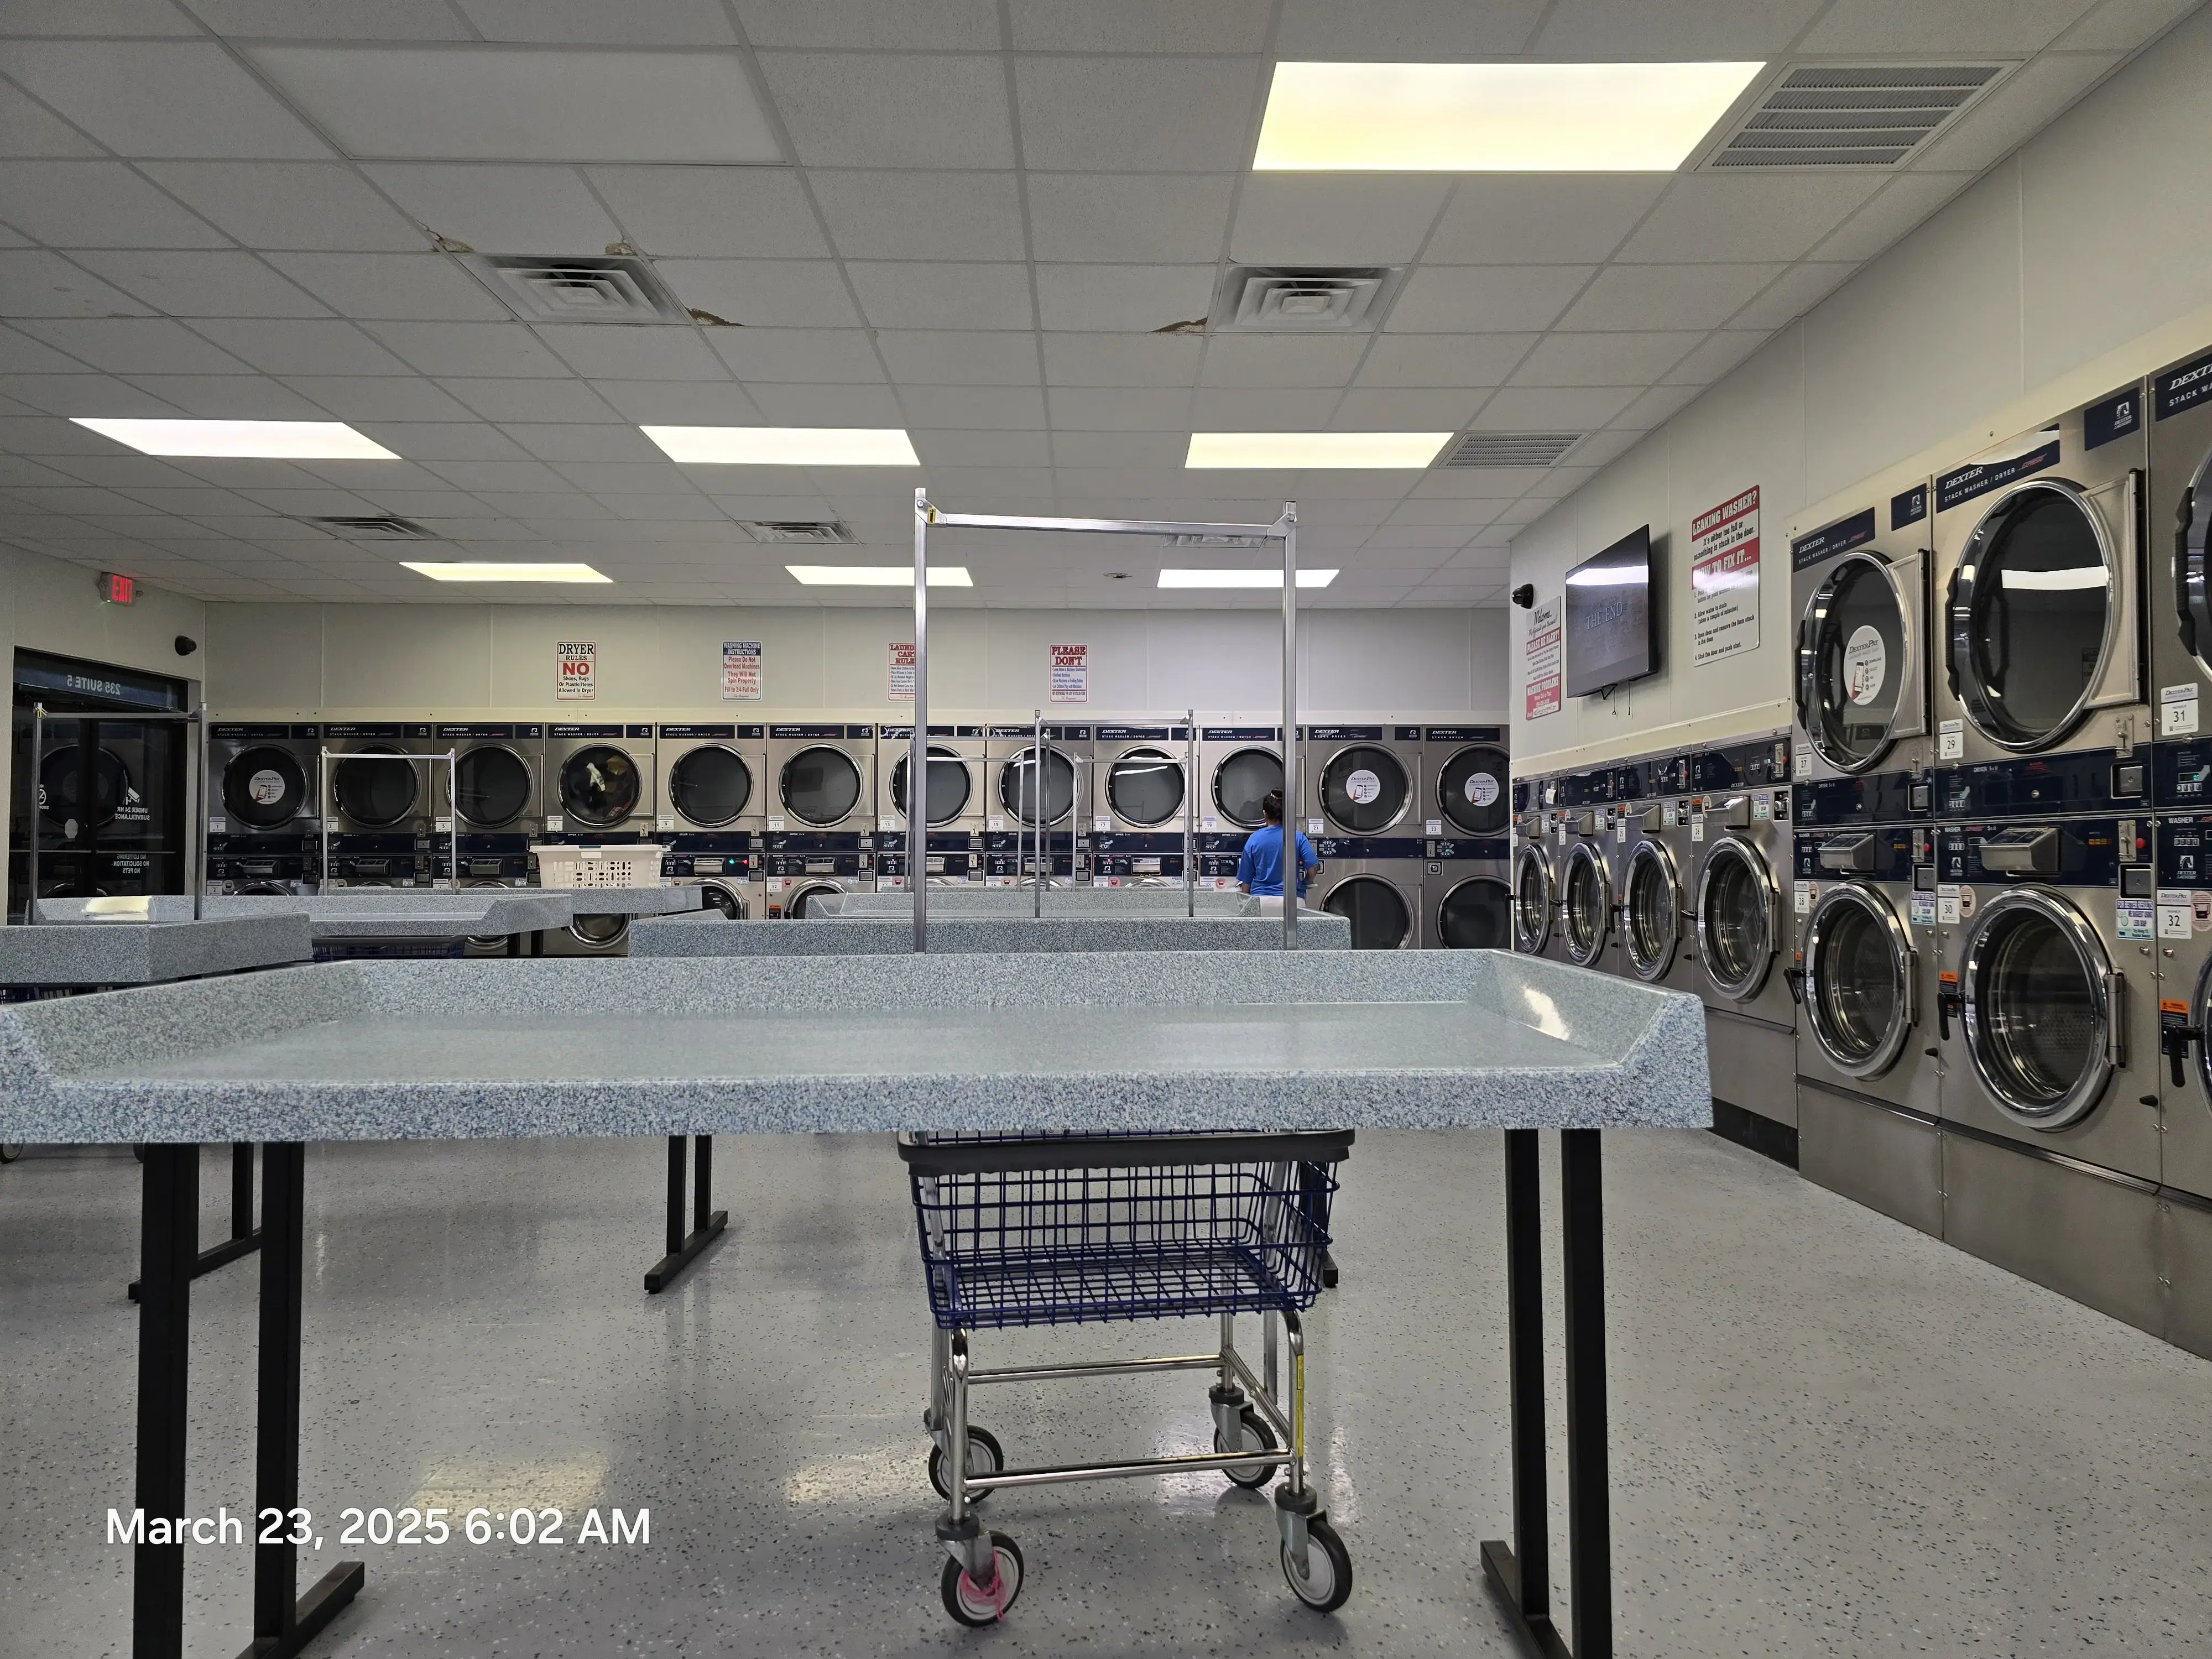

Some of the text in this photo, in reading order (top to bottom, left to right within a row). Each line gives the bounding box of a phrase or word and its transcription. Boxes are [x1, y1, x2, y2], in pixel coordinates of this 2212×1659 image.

[2168, 363, 2212, 390] DEXT
[2169, 389, 2197, 406] STACK
[1944, 466, 1984, 490] DEXTER
[1944, 467, 2015, 503] STACK WASHER DRYER
[1693, 490, 1757, 536] LEAKING WASHER?
[1710, 531, 1722, 542] either
[1694, 546, 1713, 561] something
[1719, 537, 1730, 549] stuck
[1731, 535, 1735, 544] in
[1744, 526, 1755, 537] door.
[1798, 536, 1824, 553] DEXTER
[1798, 540, 1846, 564] STACK WASHER DRYER
[1712, 559, 1721, 573] TO
[1724, 553, 1735, 571] FIX
[1585, 601, 1623, 630] THE END
[1709, 612, 1720, 620] couple
[1745, 614, 1755, 623] stuck
[559, 644, 594, 654] DRYER
[1052, 646, 1086, 655] PLEASE
[1055, 656, 1082, 665] DON'T
[562, 662, 589, 675] NO
[2173, 710, 2185, 722] 31
[1947, 740, 1955, 749] 29
[1944, 904, 1953, 914] 30
[2168, 915, 2180, 926] 32
